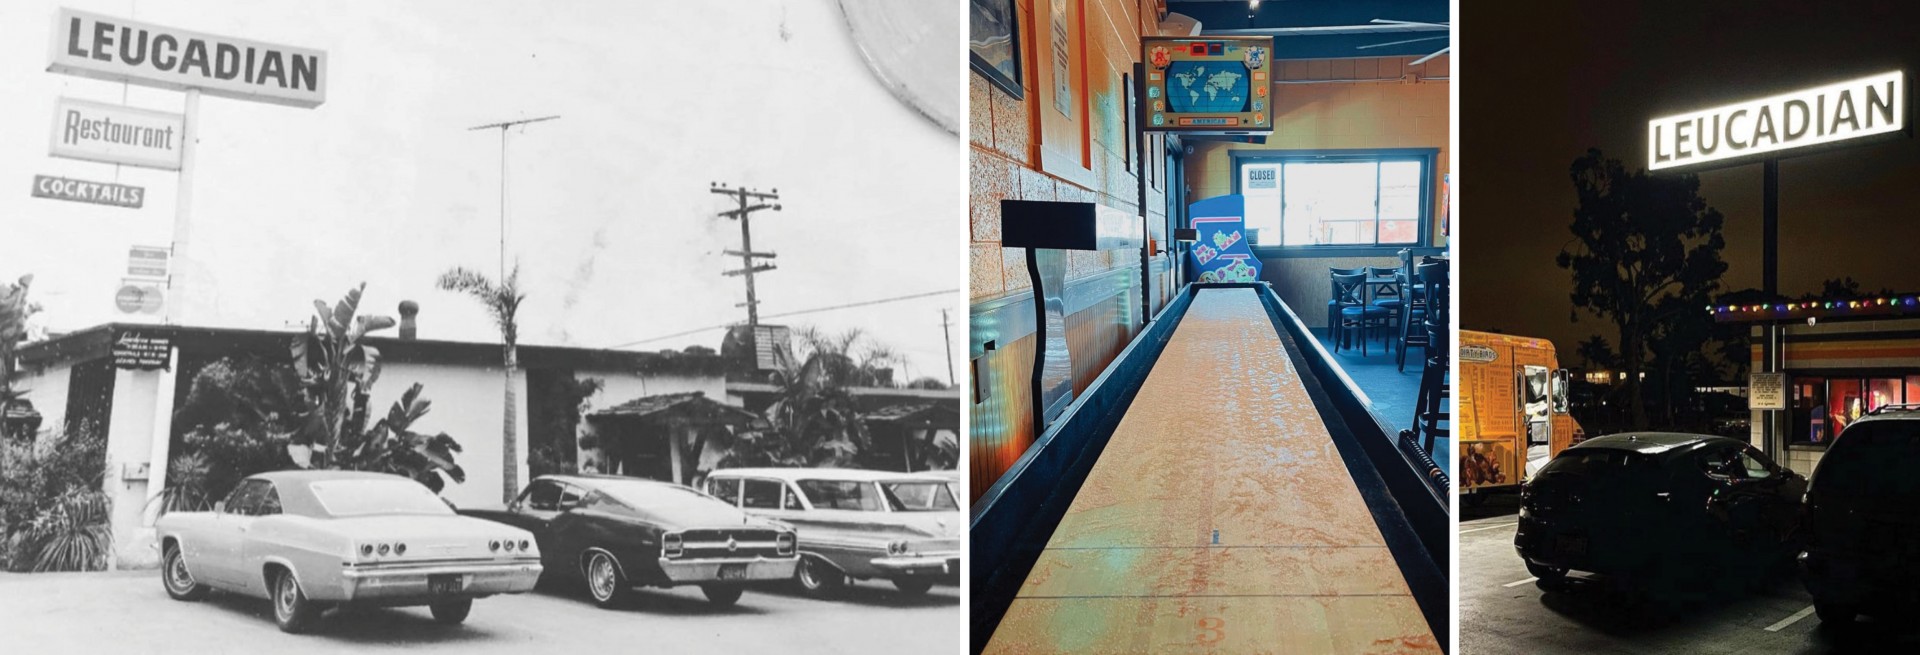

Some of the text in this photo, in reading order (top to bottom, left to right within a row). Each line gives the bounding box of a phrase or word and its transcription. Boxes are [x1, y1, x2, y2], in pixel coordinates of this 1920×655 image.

[67, 17, 318, 92] LEUCADIAN
[63, 109, 173, 150] Restaurant
[1655, 80, 1895, 163] LEUCADIAN
[39, 178, 141, 204] COCKTAILS
[1249, 170, 1275, 180] CLOSED
